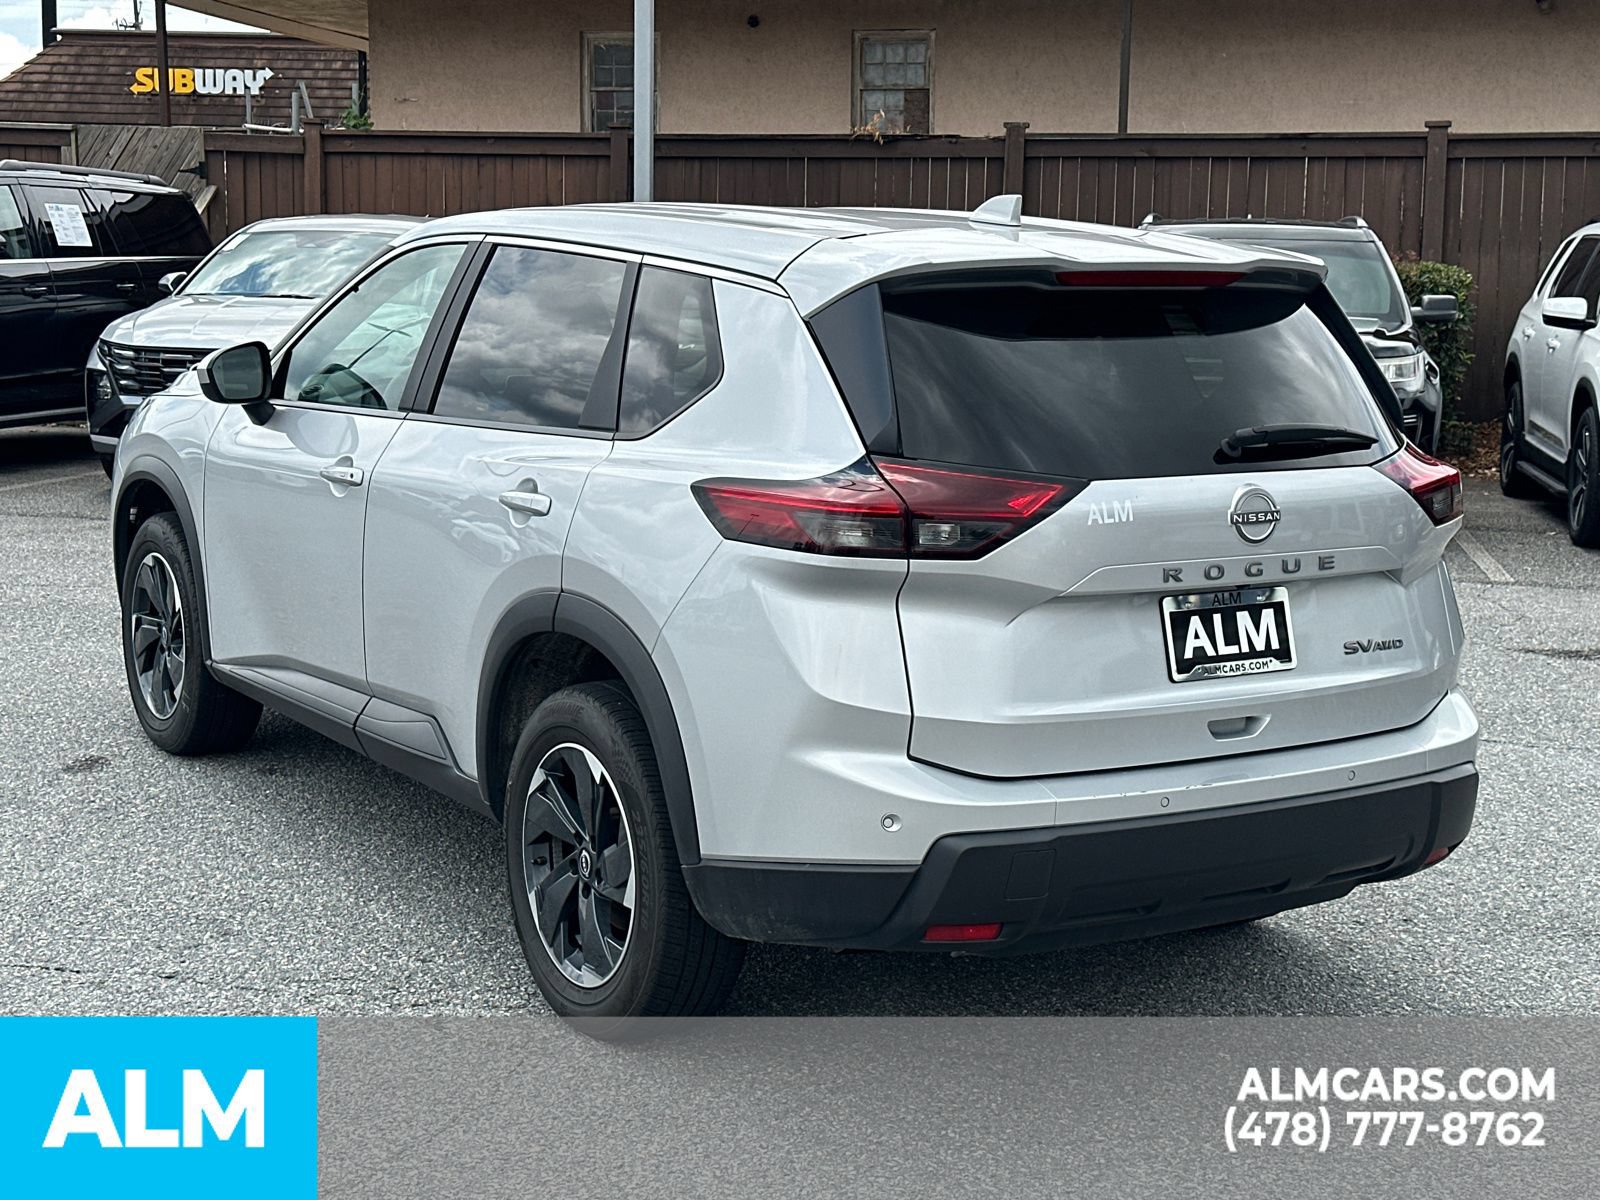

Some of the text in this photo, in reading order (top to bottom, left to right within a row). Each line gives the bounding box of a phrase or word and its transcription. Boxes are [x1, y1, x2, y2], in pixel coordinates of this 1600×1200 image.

[1087, 499, 1134, 526] ALM
[1232, 512, 1280, 523] NISSAN
[1162, 555, 1336, 584] ROGUE
[1211, 592, 1243, 607] ALM
[1183, 607, 1281, 660] ALM
[1343, 639, 1372, 655] SV
[1203, 660, 1270, 676] ALMCARS.COM
